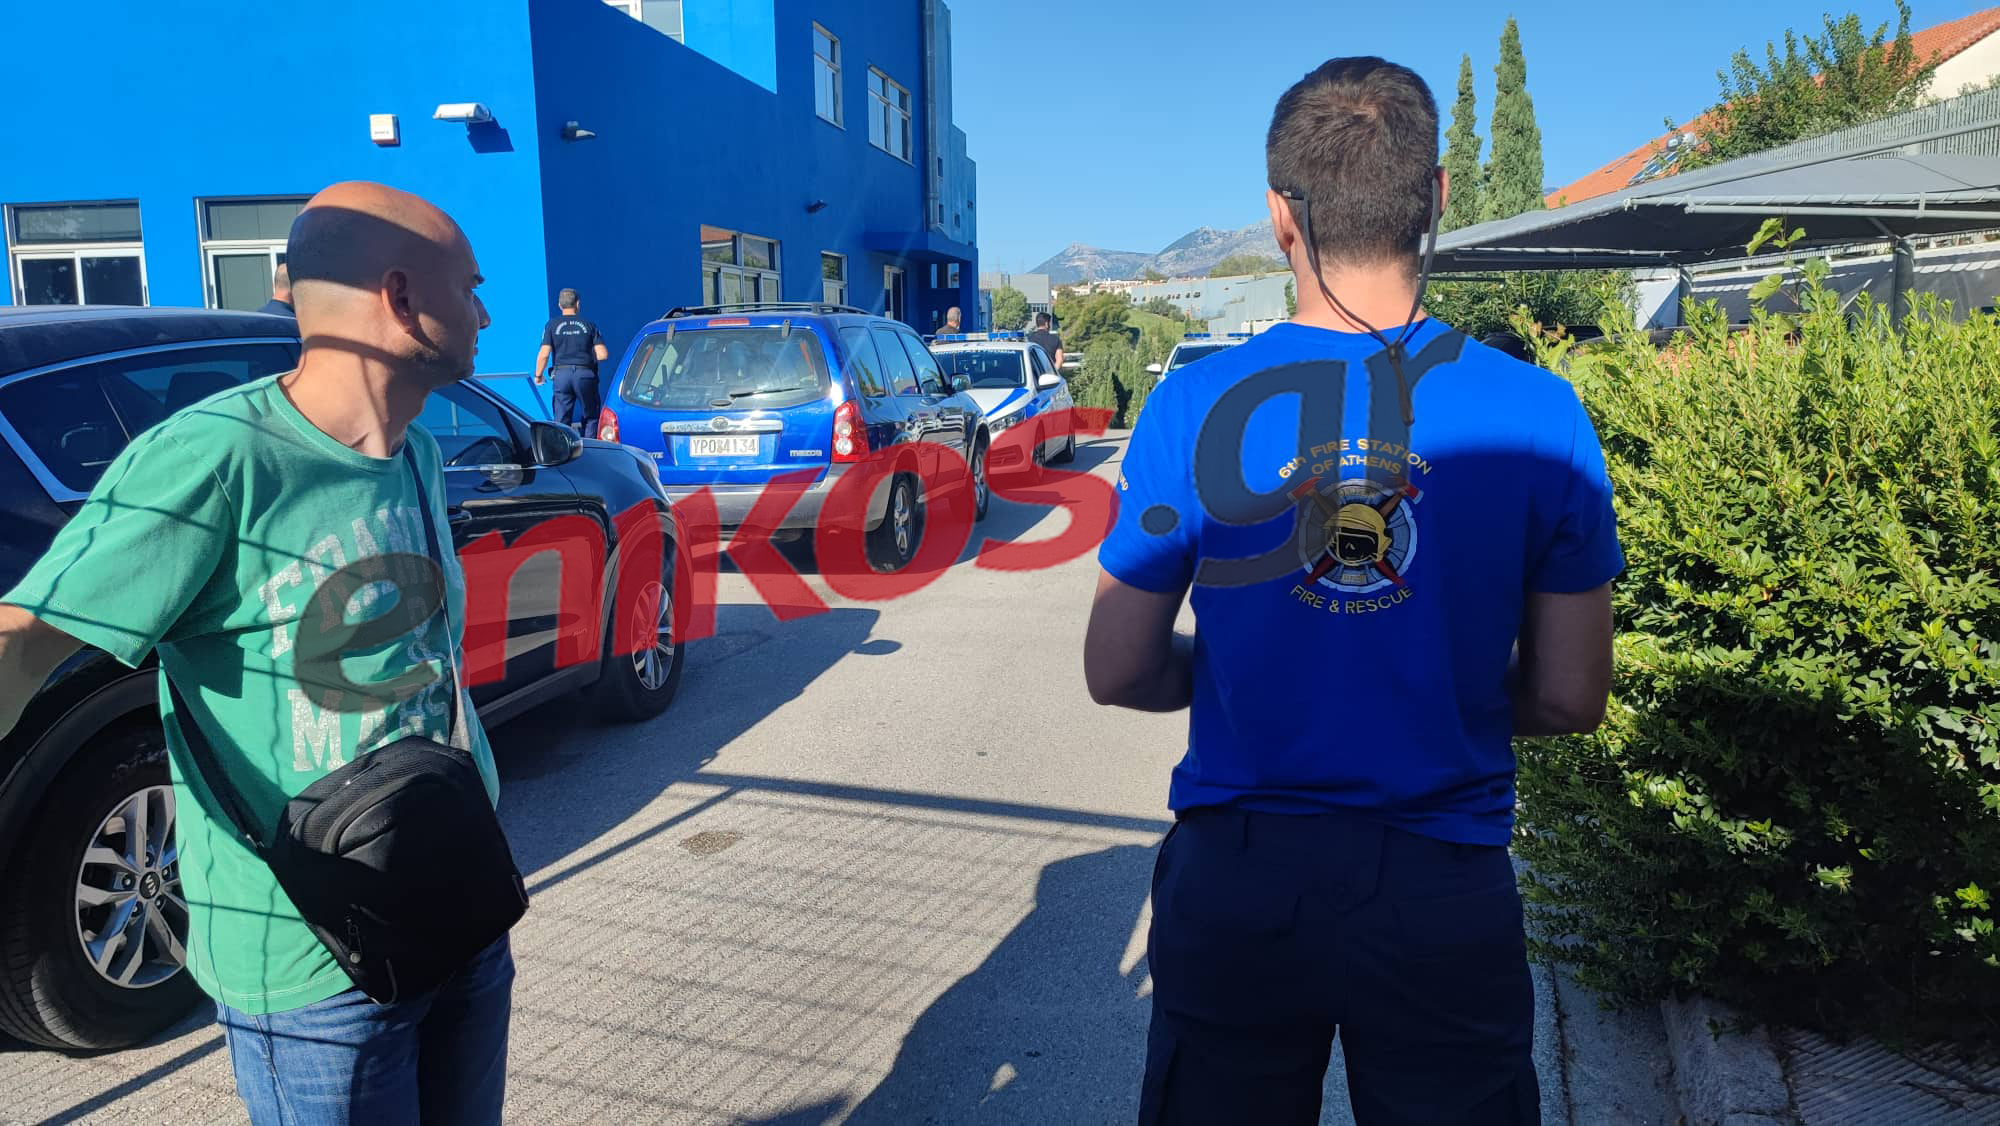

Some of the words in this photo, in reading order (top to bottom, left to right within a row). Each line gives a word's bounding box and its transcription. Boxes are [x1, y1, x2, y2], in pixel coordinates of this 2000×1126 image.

[1278, 455, 1307, 479] 6th
[1310, 439, 1351, 459] FIRE
[1357, 438, 1433, 476] STATION
[1311, 459, 1334, 475] OF
[1339, 454, 1402, 475] ATHENS
[1290, 584, 1327, 609] FIRE
[1328, 599, 1340, 613] &
[1345, 586, 1414, 614] RESCUE
